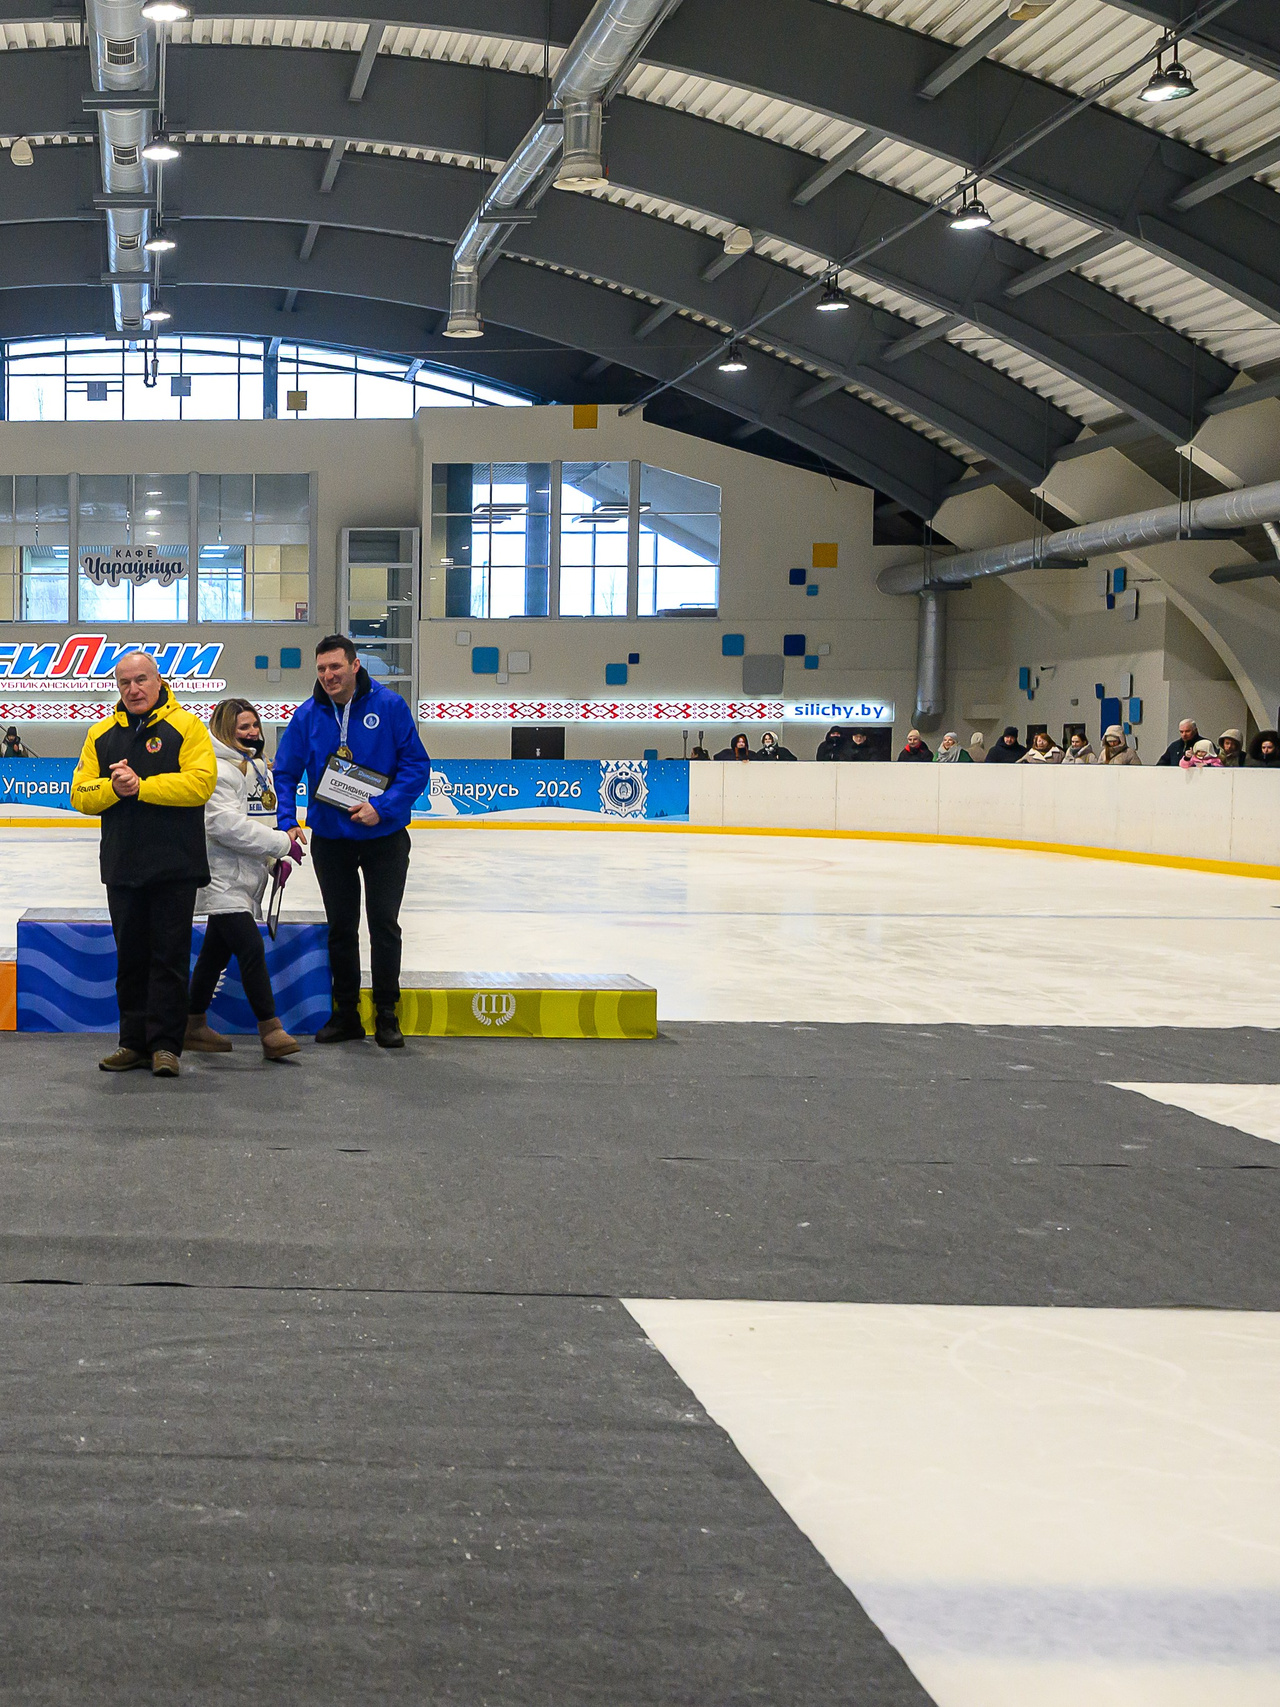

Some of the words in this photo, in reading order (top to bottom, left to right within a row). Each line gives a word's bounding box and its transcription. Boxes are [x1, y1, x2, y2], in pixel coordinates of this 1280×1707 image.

[116, 549, 153, 558] КАФЕ
[187, 681, 224, 691] ЦЕНТР
[794, 703, 884, 719] silichy.by
[3, 777, 71, 798] Управл
[429, 779, 519, 798] Беларусь
[535, 780, 582, 797] 2026
[480, 994, 510, 1014] III
